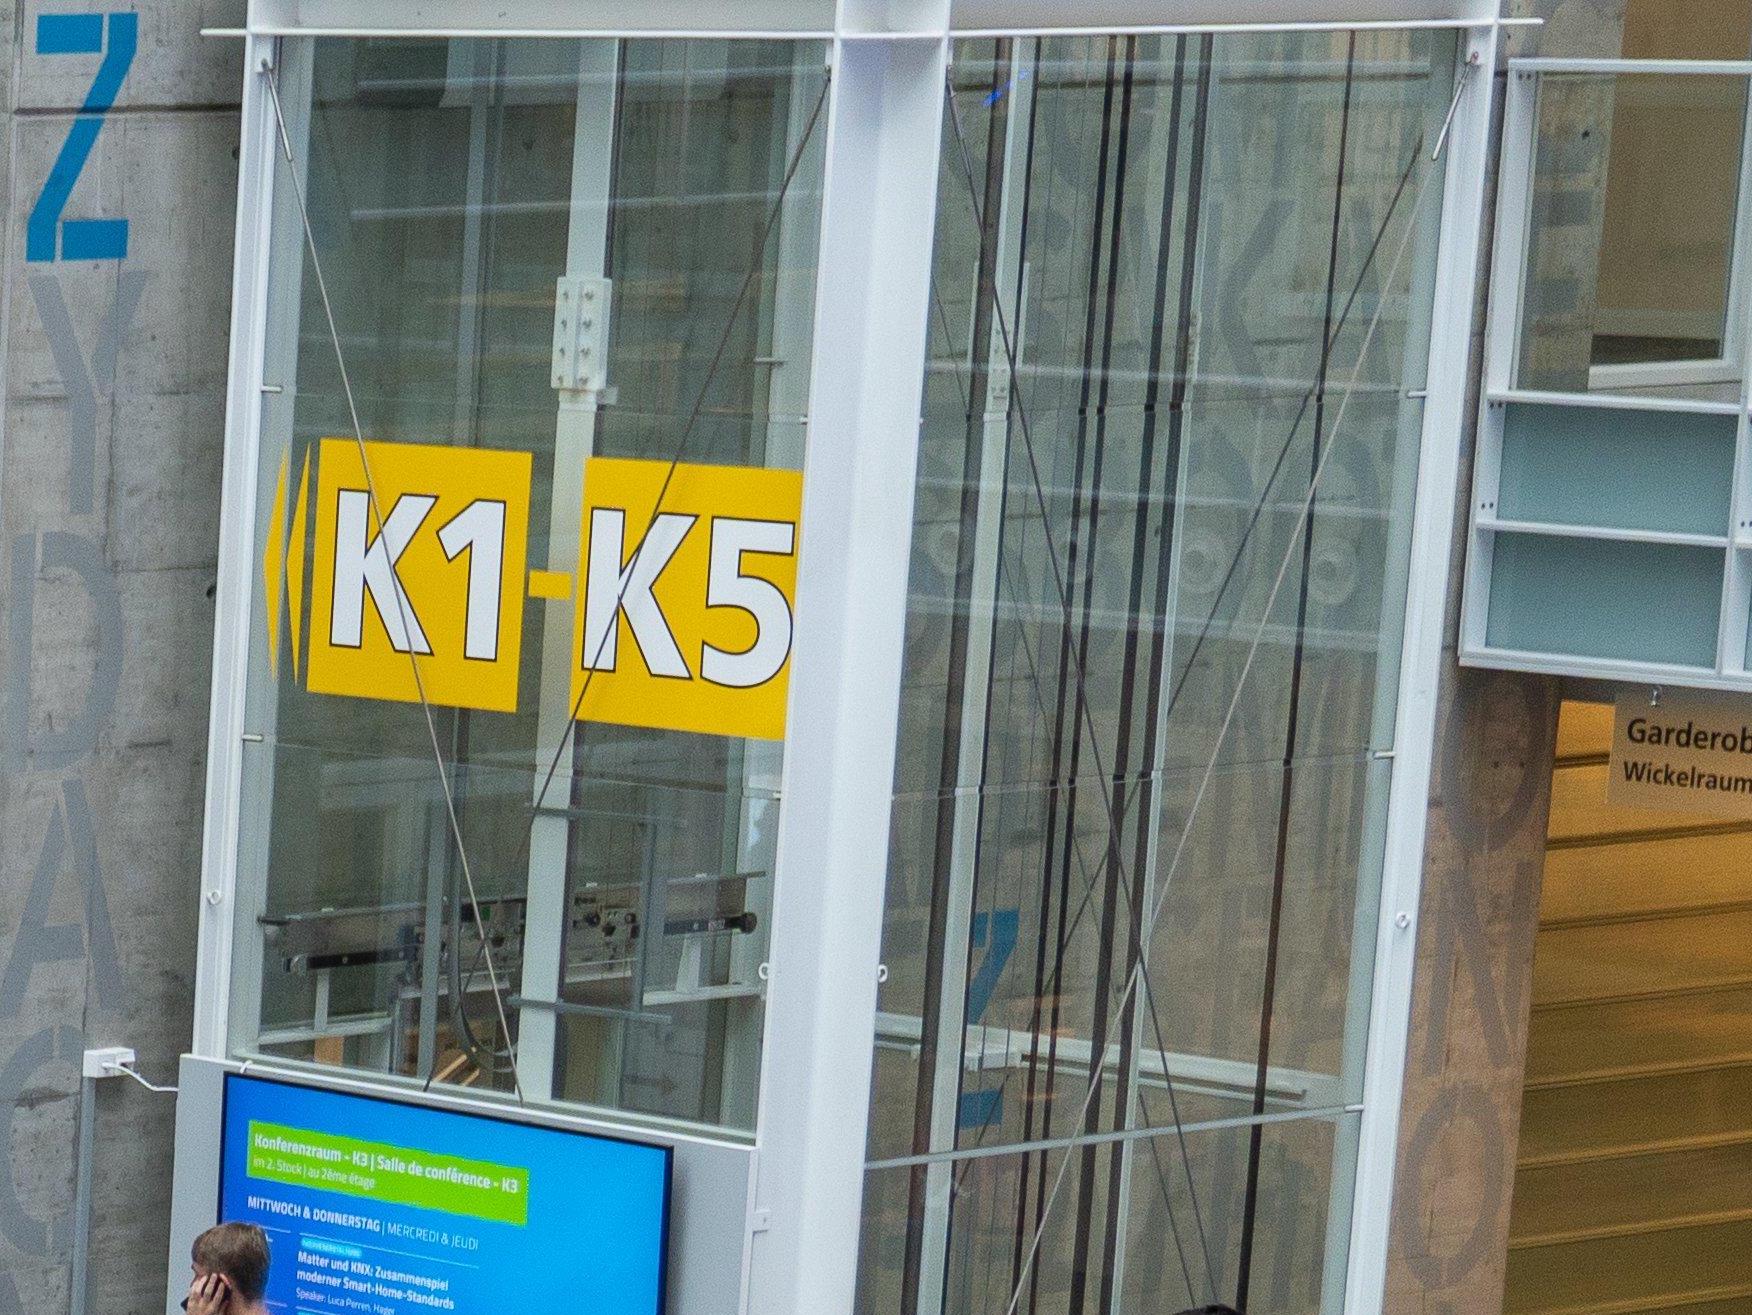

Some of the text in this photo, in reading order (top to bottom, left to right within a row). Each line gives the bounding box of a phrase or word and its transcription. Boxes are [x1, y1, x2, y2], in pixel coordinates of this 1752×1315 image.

[254, 1134, 342, 1167] Konferenzraum
[352, 1153, 368, 1168] K3
[377, 1155, 405, 1174] Salle
[407, 1160, 423, 1178] de
[502, 1177, 519, 1194] K3
[247, 1195, 301, 1218] MITTWOCH
[312, 1206, 381, 1233] DONNERSTAG
[387, 1221, 440, 1244] MERCREDI
[451, 1234, 479, 1251] JEUDI
[296, 1269, 341, 1289] moderner
[298, 1250, 329, 1267] Matter
[331, 1258, 349, 1273] und
[375, 1265, 449, 1292] Zusammenspiel
